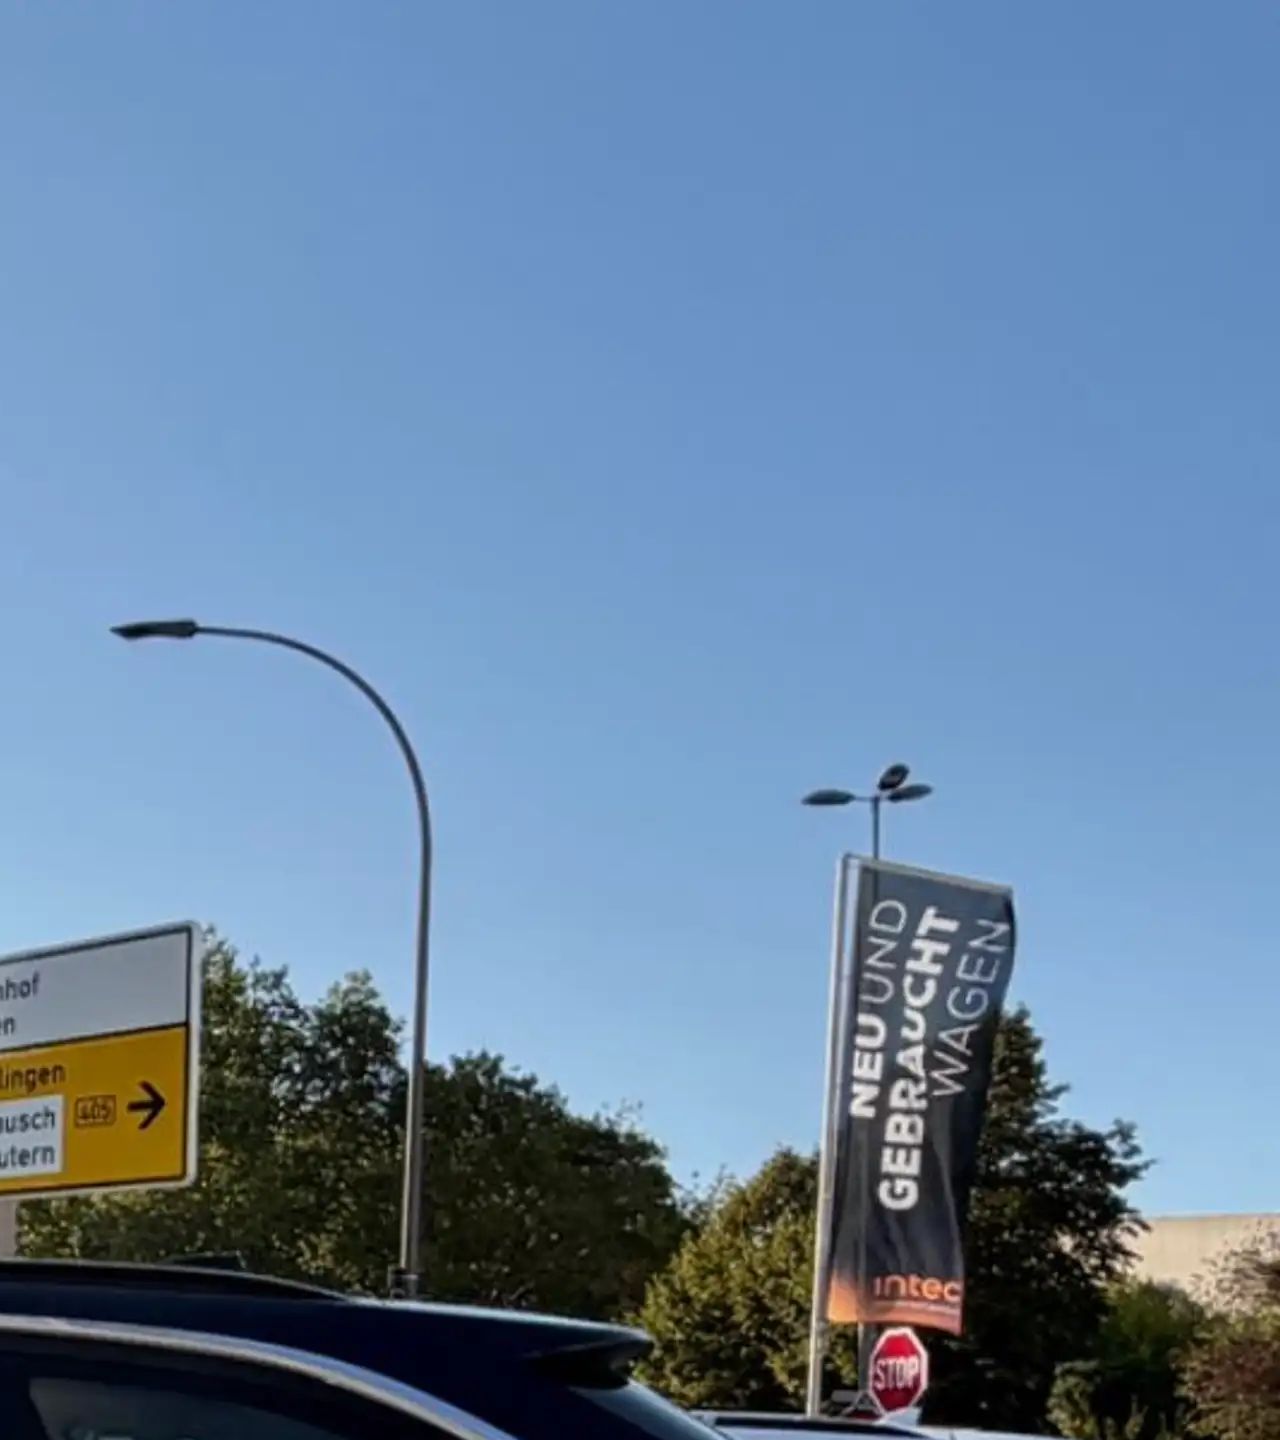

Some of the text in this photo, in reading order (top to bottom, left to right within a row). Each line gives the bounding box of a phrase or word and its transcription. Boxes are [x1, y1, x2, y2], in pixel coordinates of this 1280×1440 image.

[849, 900, 908, 1119] NEU UND
[877, 906, 961, 1211] GEBRAUCHT
[930, 919, 1011, 1096] WAGEN
[874, 1273, 961, 1301] intec
[874, 1354, 919, 1391] STOP
